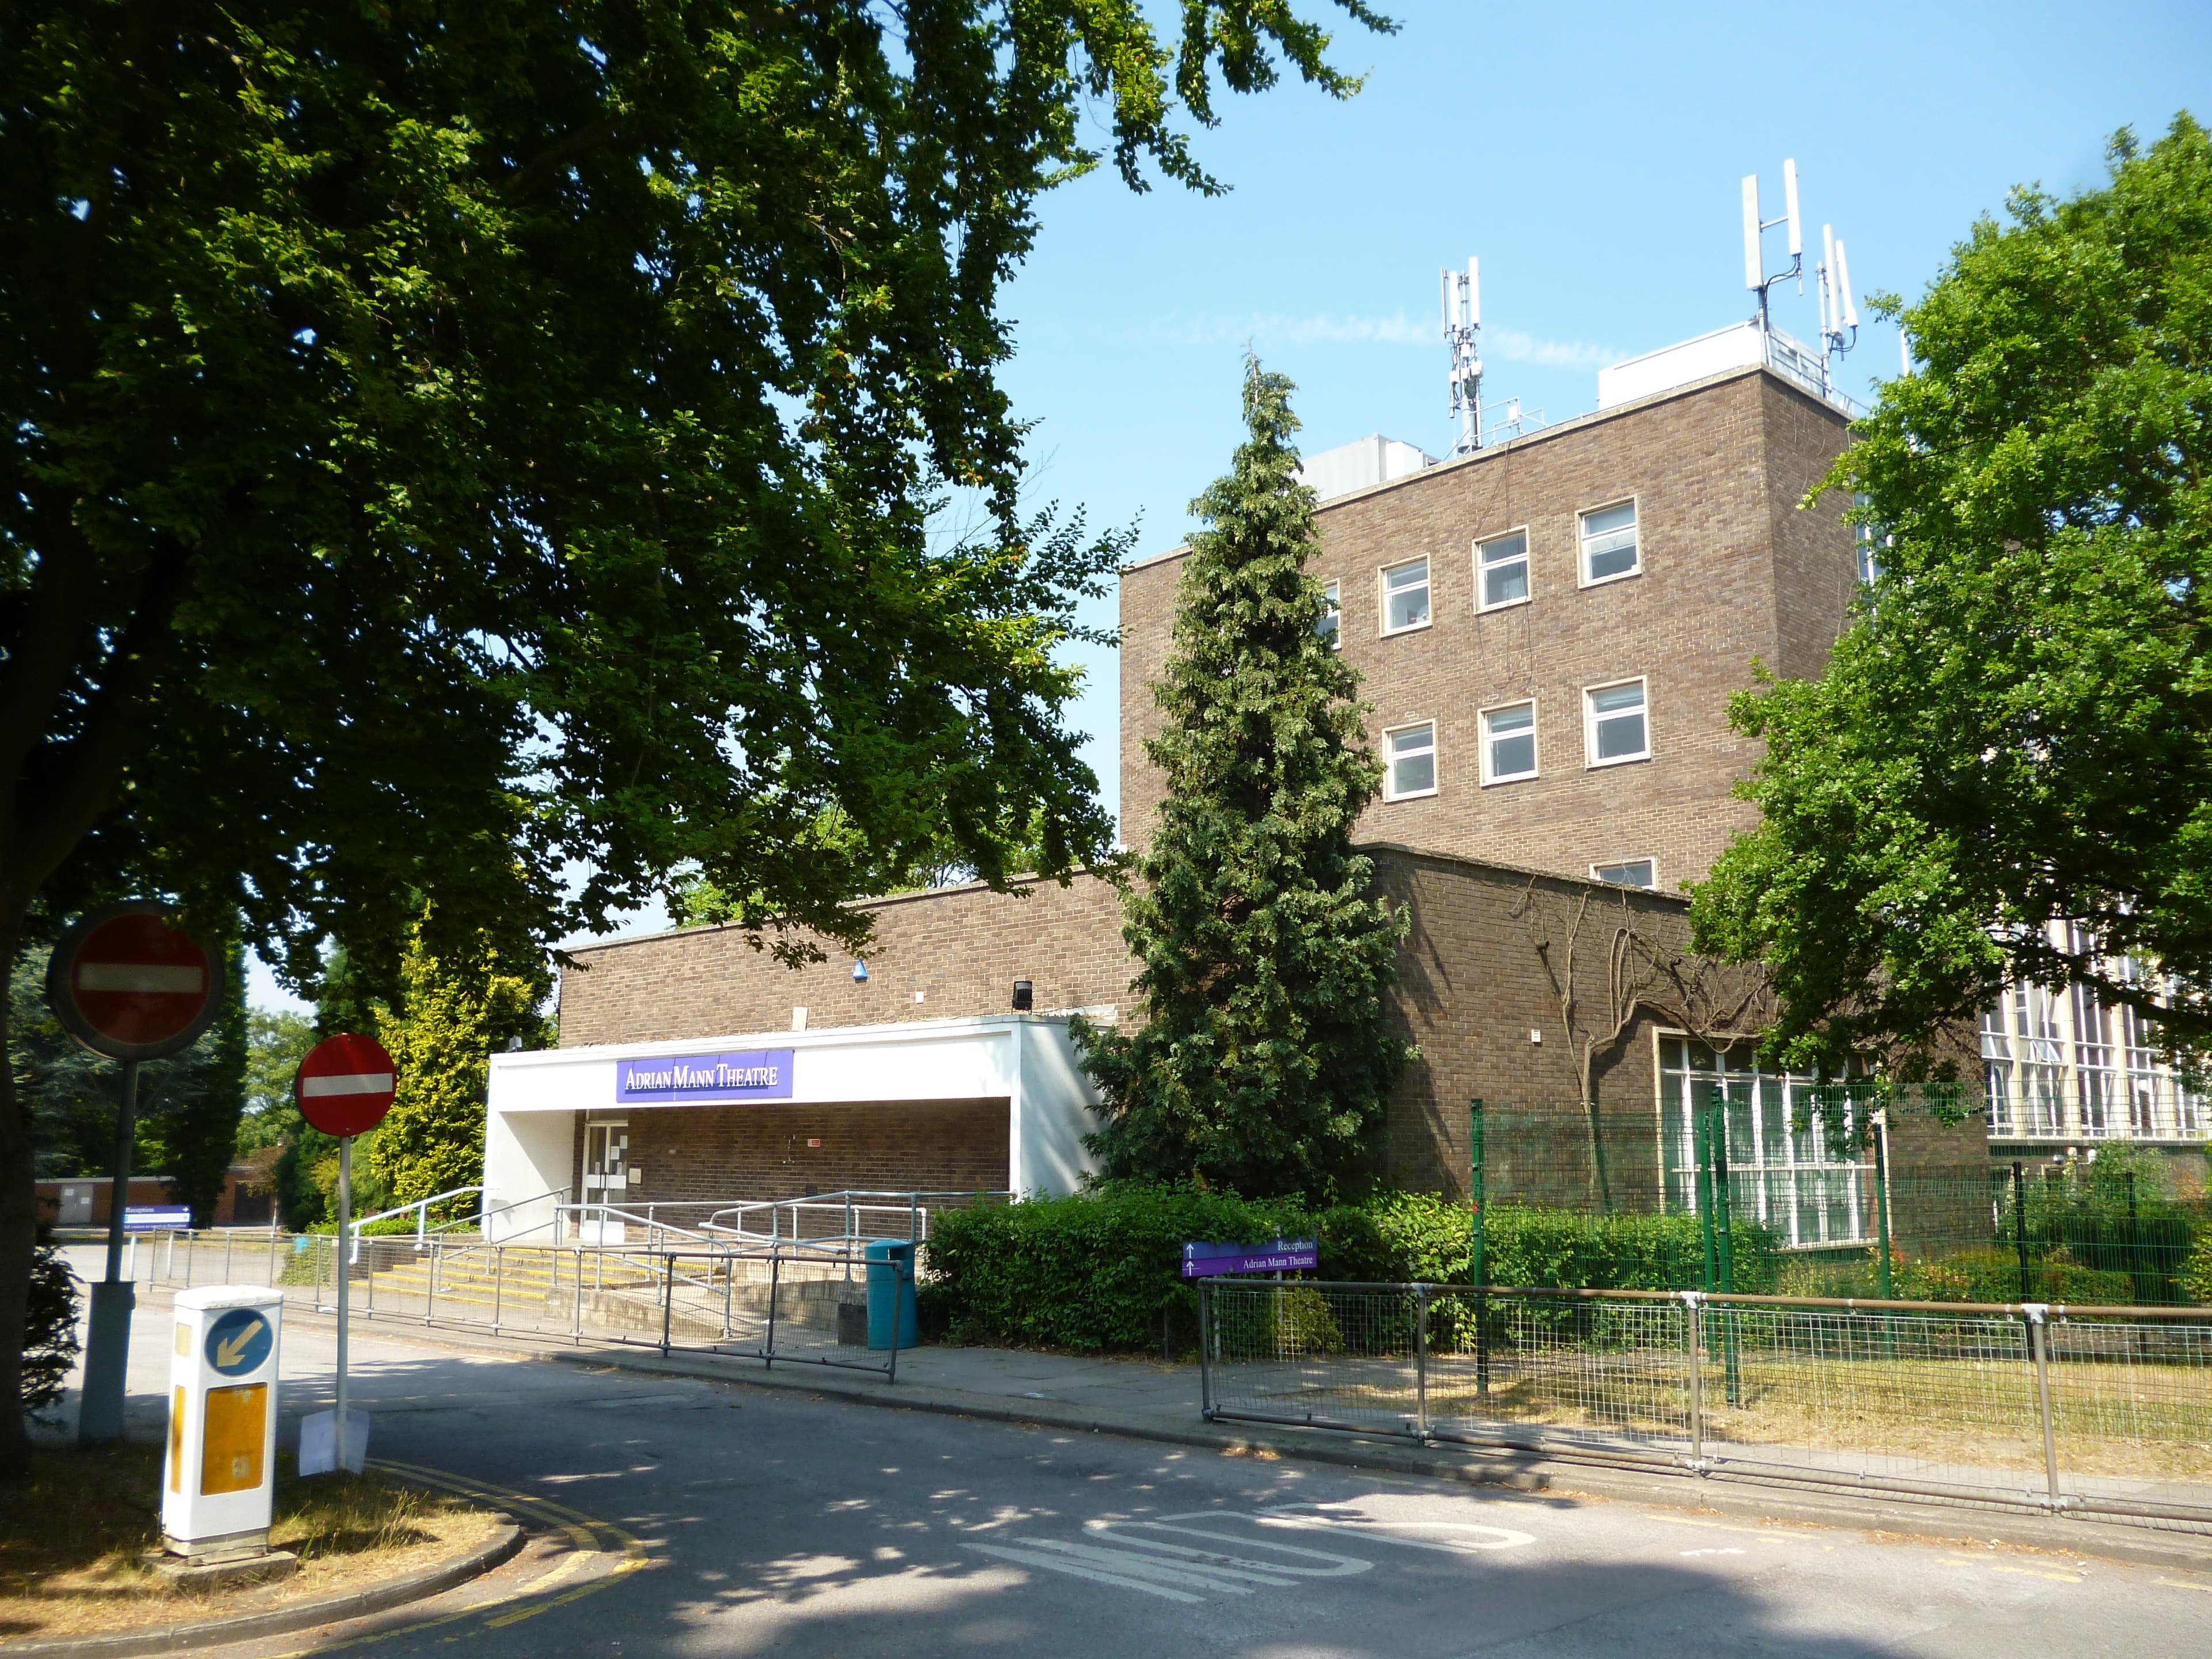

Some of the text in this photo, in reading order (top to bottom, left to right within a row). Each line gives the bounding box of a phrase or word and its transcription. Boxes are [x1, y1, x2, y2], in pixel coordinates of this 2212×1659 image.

[625, 1063, 778, 1089] ADRIAN MANN THEATRE
[1278, 1240, 1313, 1252] Reception
[1243, 1256, 1313, 1269] Adrian Mann Theatre
[957, 1503, 1537, 1603] SLOW
